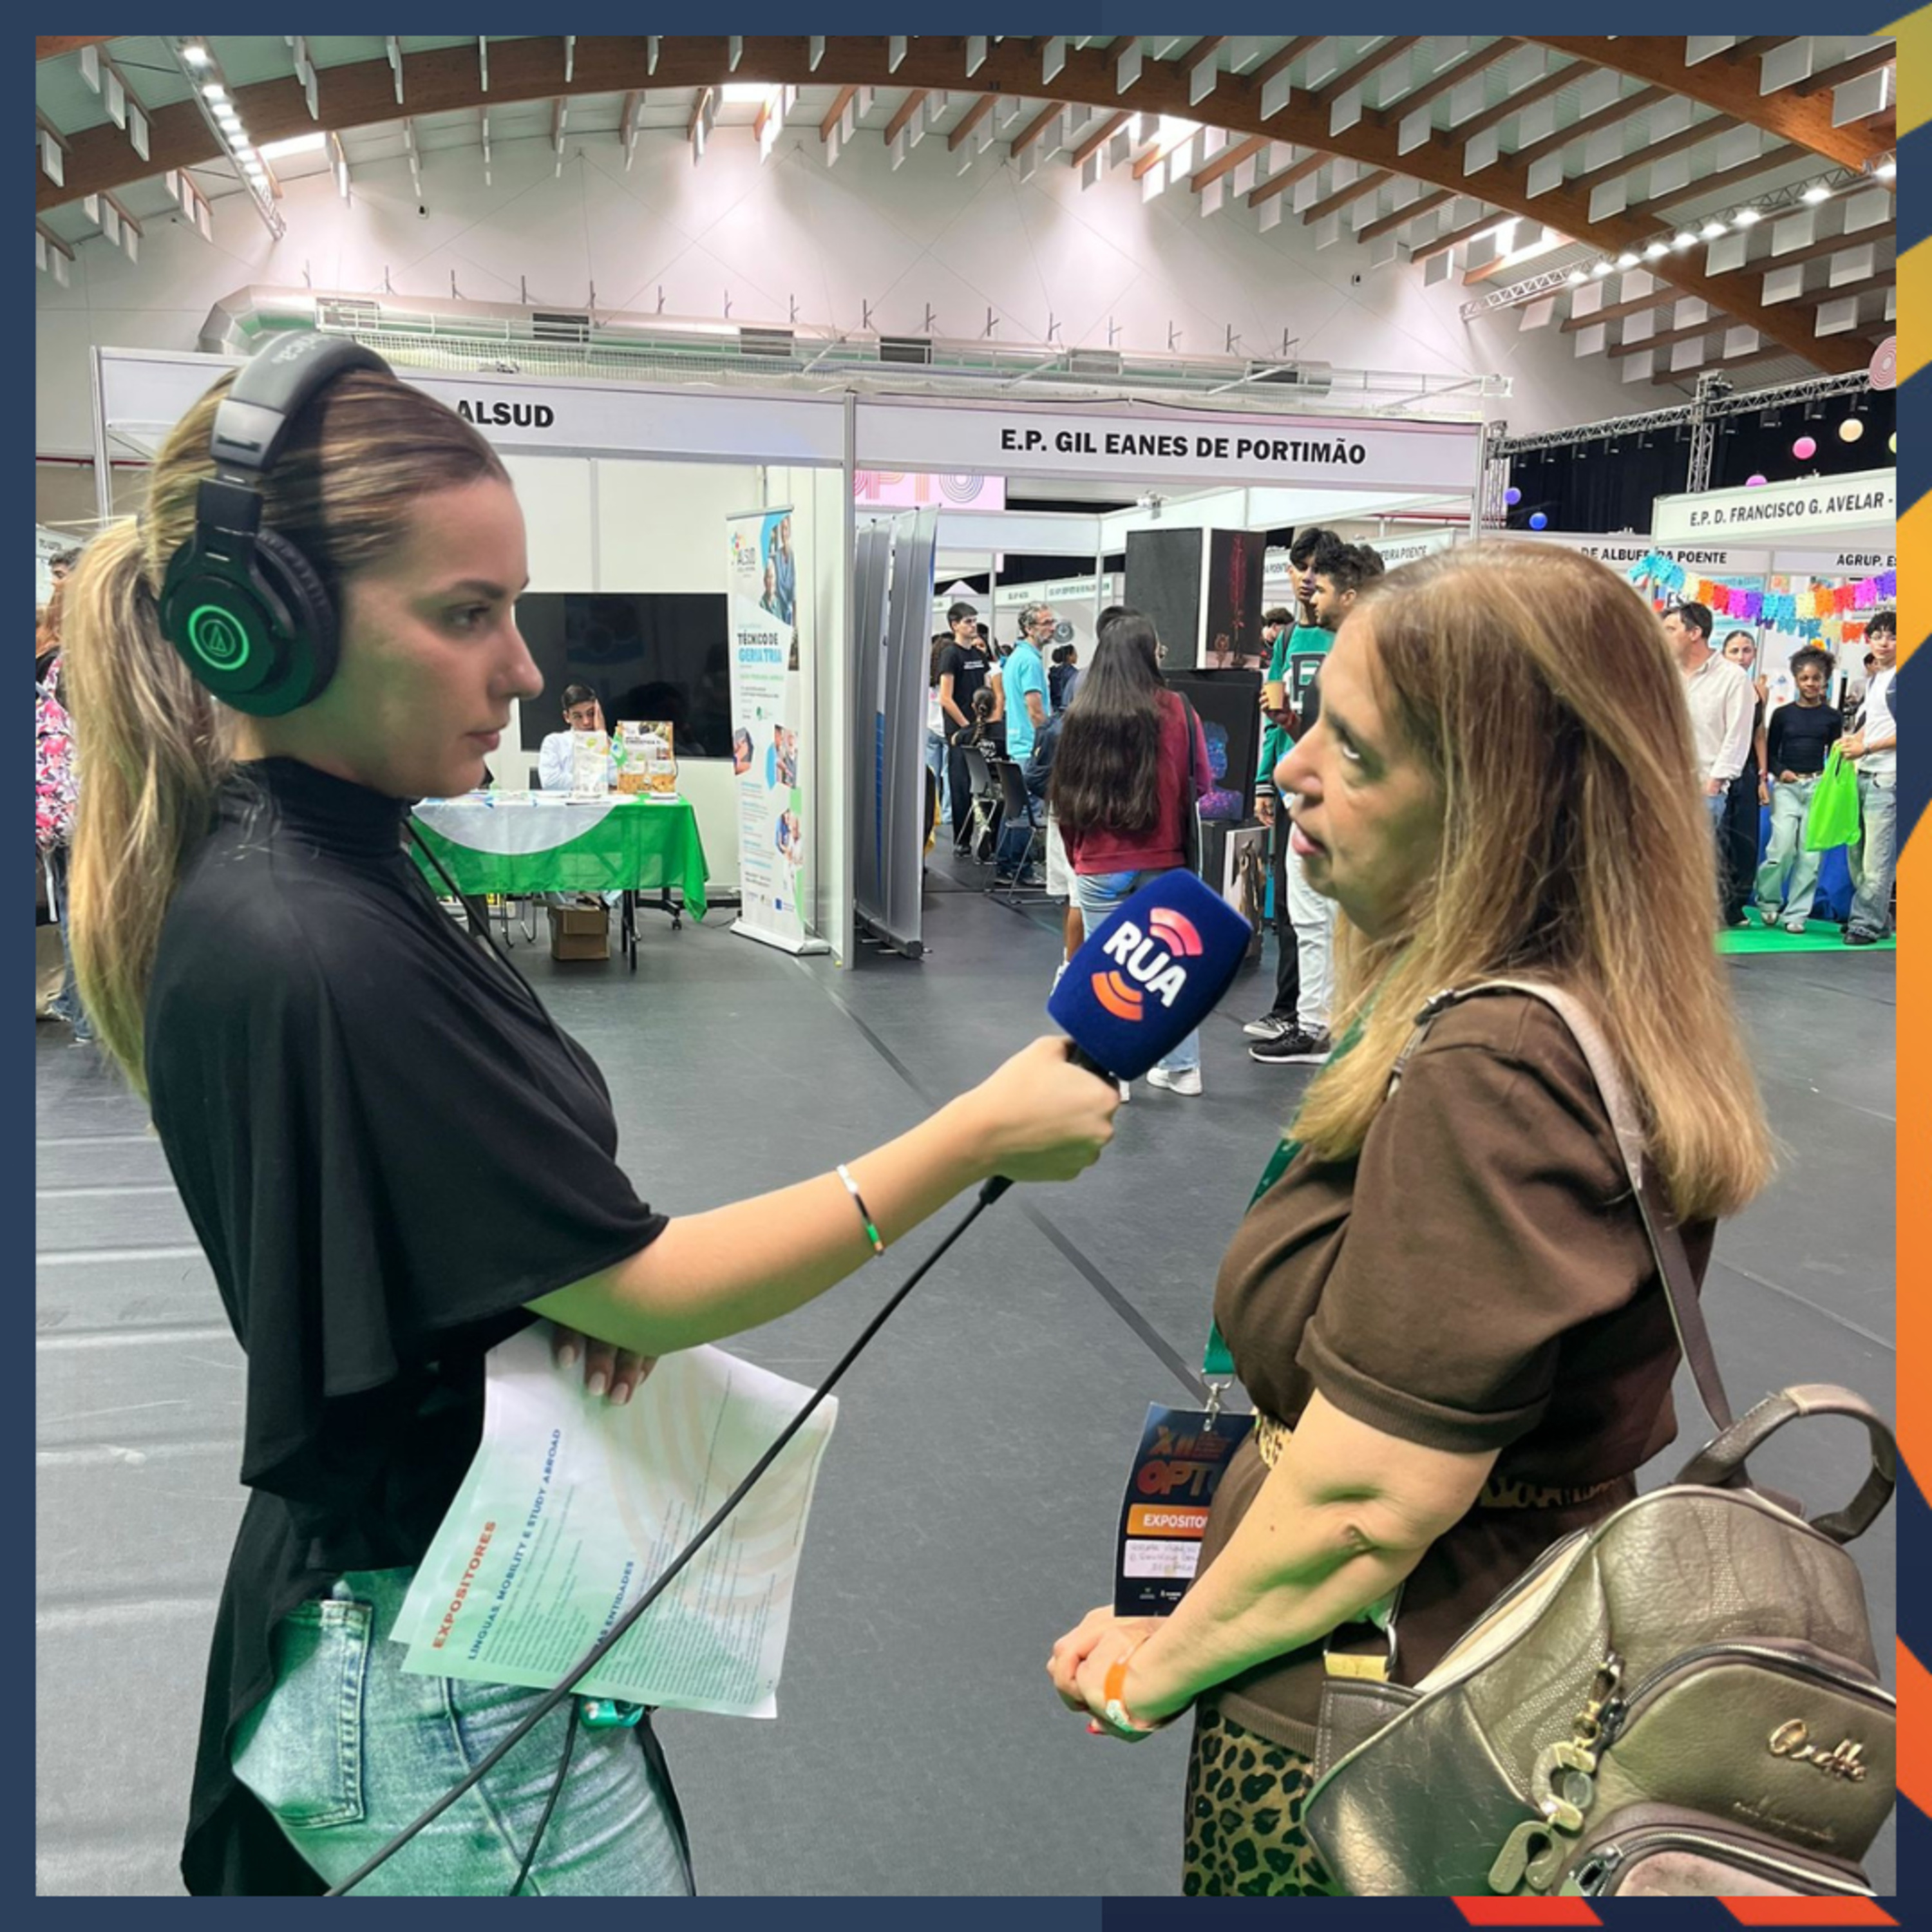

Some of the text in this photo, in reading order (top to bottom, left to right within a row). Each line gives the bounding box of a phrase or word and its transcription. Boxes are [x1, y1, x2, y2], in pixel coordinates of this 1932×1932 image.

[457, 400, 554, 428] ALSUD
[1001, 429, 1366, 465] E.P. GIL EANES DE PORTIMÃO
[1690, 511, 1711, 526] E.P.
[1714, 509, 1726, 524] D.
[1730, 500, 1804, 523] FRANCISCO
[1808, 498, 1823, 515] G.
[1826, 491, 1884, 513] AVELAR
[1677, 550, 1727, 564] POENTE
[1836, 554, 1882, 567] AGRUP.
[1103, 920, 1187, 1008] RUA
[497, 1542, 527, 1600] MOBILITY
[522, 1530, 532, 1539] E
[527, 1488, 546, 1527] STUDY
[543, 1429, 560, 1484] ABROAD
[432, 1521, 496, 1649] EXPOSITORES
[605, 1561, 634, 1626] ENTIDADES
